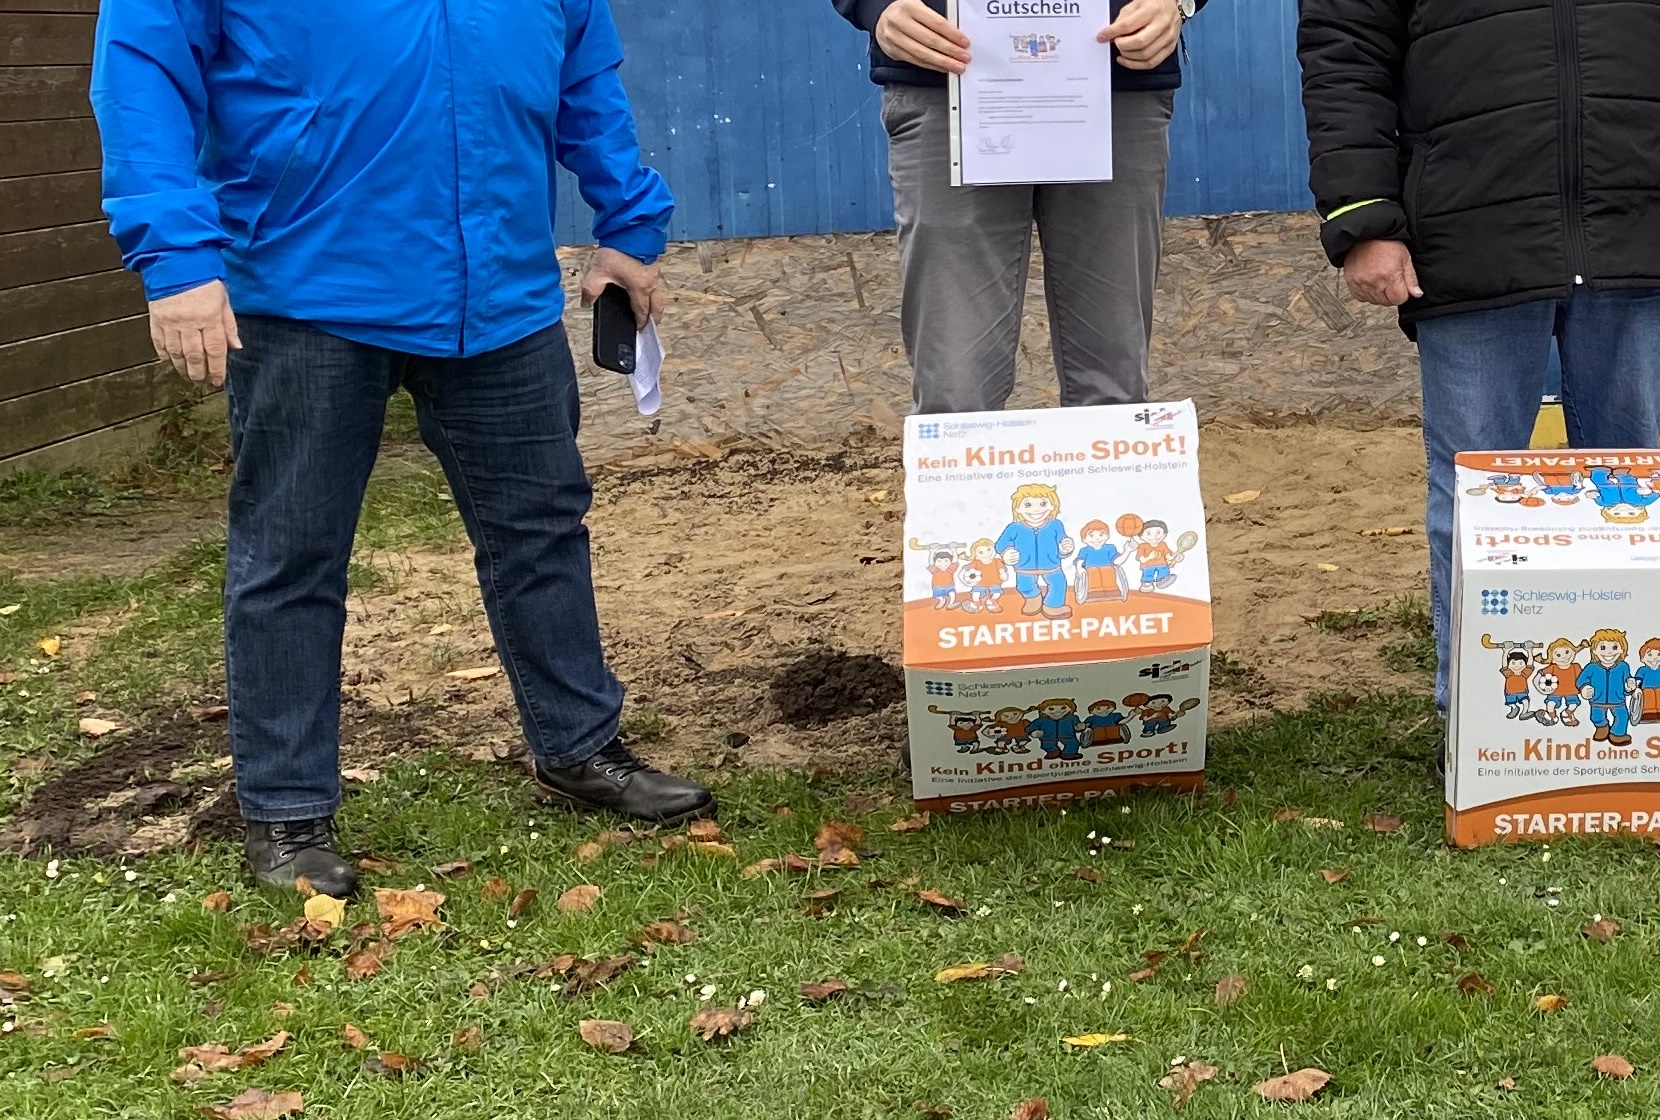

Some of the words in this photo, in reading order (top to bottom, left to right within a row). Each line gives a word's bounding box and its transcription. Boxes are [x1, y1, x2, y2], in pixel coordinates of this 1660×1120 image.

[986, 0, 1080, 15] Gutschein
[918, 456, 958, 469] Kein
[965, 444, 1035, 467] Kind
[1041, 451, 1086, 463] ohne
[1091, 433, 1186, 460] Sport!
[918, 474, 942, 483] Eine
[945, 472, 996, 481] Initiative
[996, 470, 1014, 479] der
[1018, 467, 1084, 478] Sportjugend
[1087, 461, 1188, 473] Schleswig-Holstein
[1475, 533, 1572, 547] Sport!
[1513, 589, 1632, 603] Schleswig-Holstein
[1513, 603, 1543, 615] Netz
[938, 612, 1173, 648] STARTER-PAKET
[1478, 747, 1516, 761] Kein
[1523, 738, 1591, 760] Kind
[1597, 747, 1639, 759] ohne
[931, 766, 969, 776] Kein
[976, 758, 1043, 775] Kind
[1049, 760, 1092, 770] ohne
[1096, 742, 1188, 764] Sport!
[1478, 768, 1500, 776] Eine
[1504, 767, 1549, 776] Initiative
[1553, 767, 1570, 775] der
[1573, 765, 1637, 776] Sportjugend
